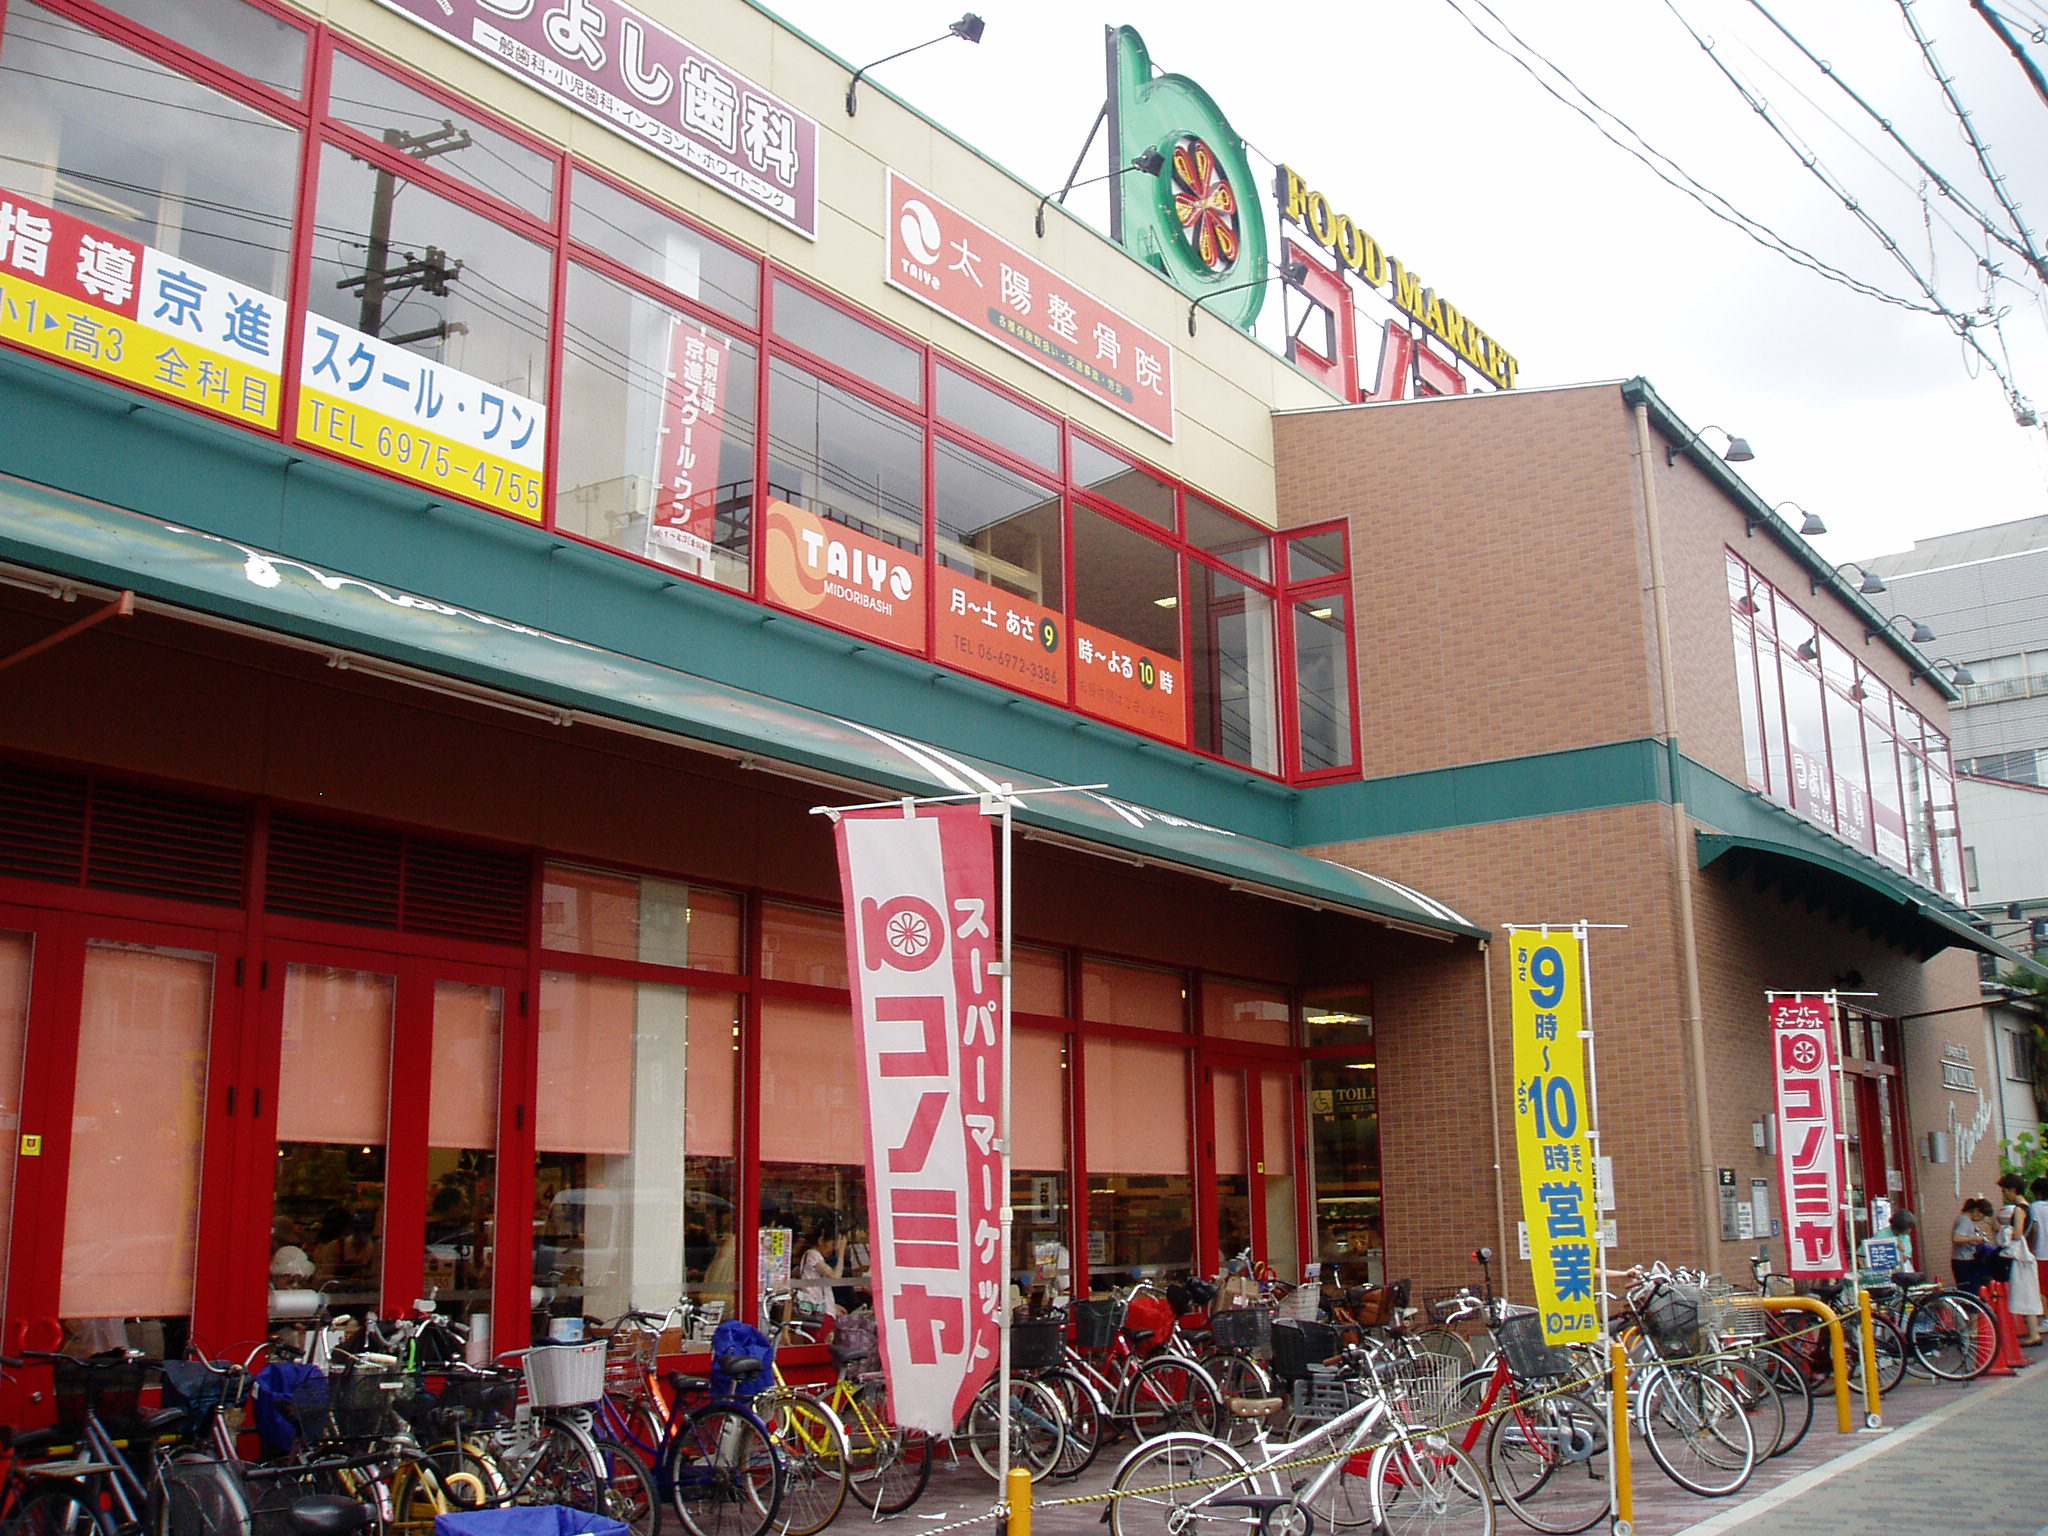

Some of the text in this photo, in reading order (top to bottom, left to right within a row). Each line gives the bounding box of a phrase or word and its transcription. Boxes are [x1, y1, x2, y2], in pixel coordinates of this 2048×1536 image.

[476, 0, 798, 187] よし歯科
[154, 268, 271, 357] 京進
[949, 238, 1164, 396] 太陽整骨院
[1277, 164, 1519, 390] FOOD MARKET
[154, 346, 269, 417] 全科目
[312, 326, 536, 450] スクール・ワン
[671, 335, 705, 526] 京進スクール・ワン
[700, 345, 720, 415] 個別指導
[310, 398, 540, 509] TEL 6975-4755
[823, 579, 893, 617] MIDORIBASHI
[1005, 608, 1036, 642] あさ
[953, 634, 1057, 685] TEL 06-6972-3386
[1775, 1017, 1824, 1028] マーケット
[1779, 1006, 1819, 1017] スーパー
[874, 996, 964, 1365] コノミヤ
[954, 898, 999, 1373] スーパーマーケット
[1783, 1078, 1834, 1265] コノミヤ
